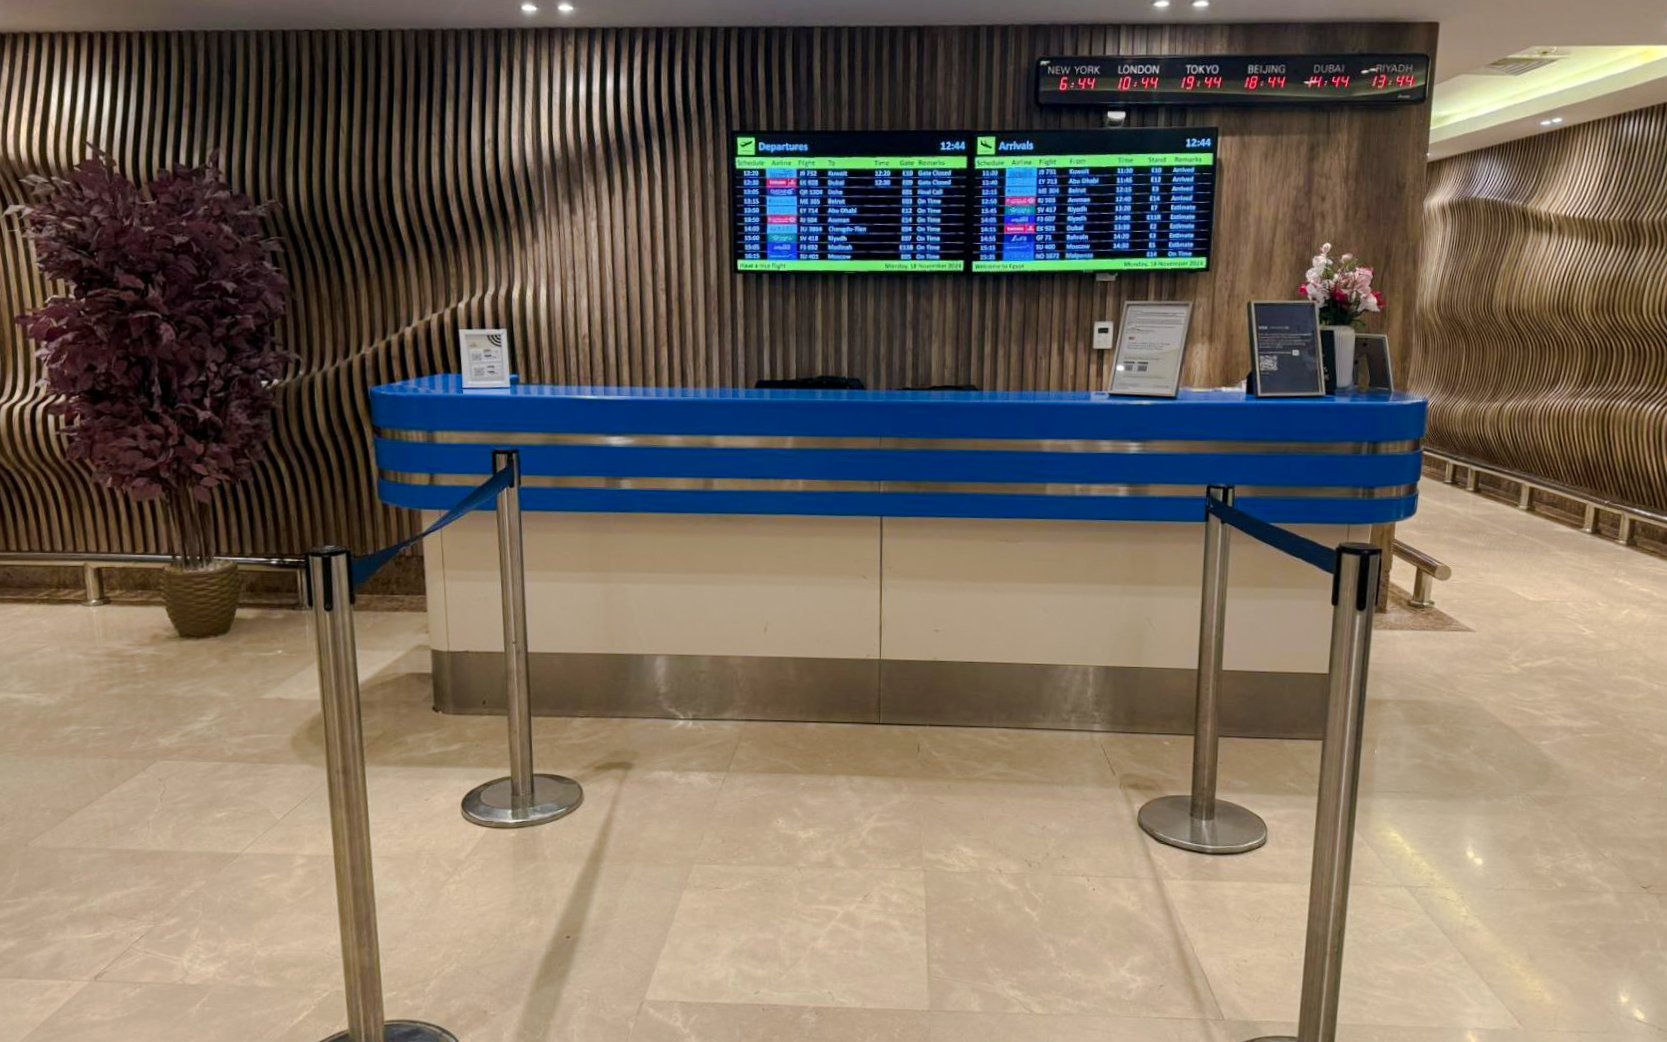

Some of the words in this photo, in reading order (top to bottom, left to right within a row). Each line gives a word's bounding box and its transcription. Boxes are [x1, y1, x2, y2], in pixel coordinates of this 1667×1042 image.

[1047, 66, 1070, 75] NEW
[1074, 66, 1100, 74] YORK
[1118, 65, 1160, 74] LONDON
[1186, 64, 1219, 74] TOKYO
[1248, 64, 1286, 74] BEIJING
[1314, 64, 1345, 73] DUBAI
[1376, 64, 1413, 73] RIYADH
[1059, 77, 1096, 90] 6:44
[1118, 78, 1158, 90] 10:44
[1181, 76, 1222, 90] 19:44
[1245, 76, 1286, 90] 18:44
[1372, 76, 1414, 88] 13:44
[758, 142, 808, 153] Departures
[940, 142, 966, 150] 12:44
[999, 141, 1034, 150] Arrivals
[1186, 138, 1212, 148] 12:44
